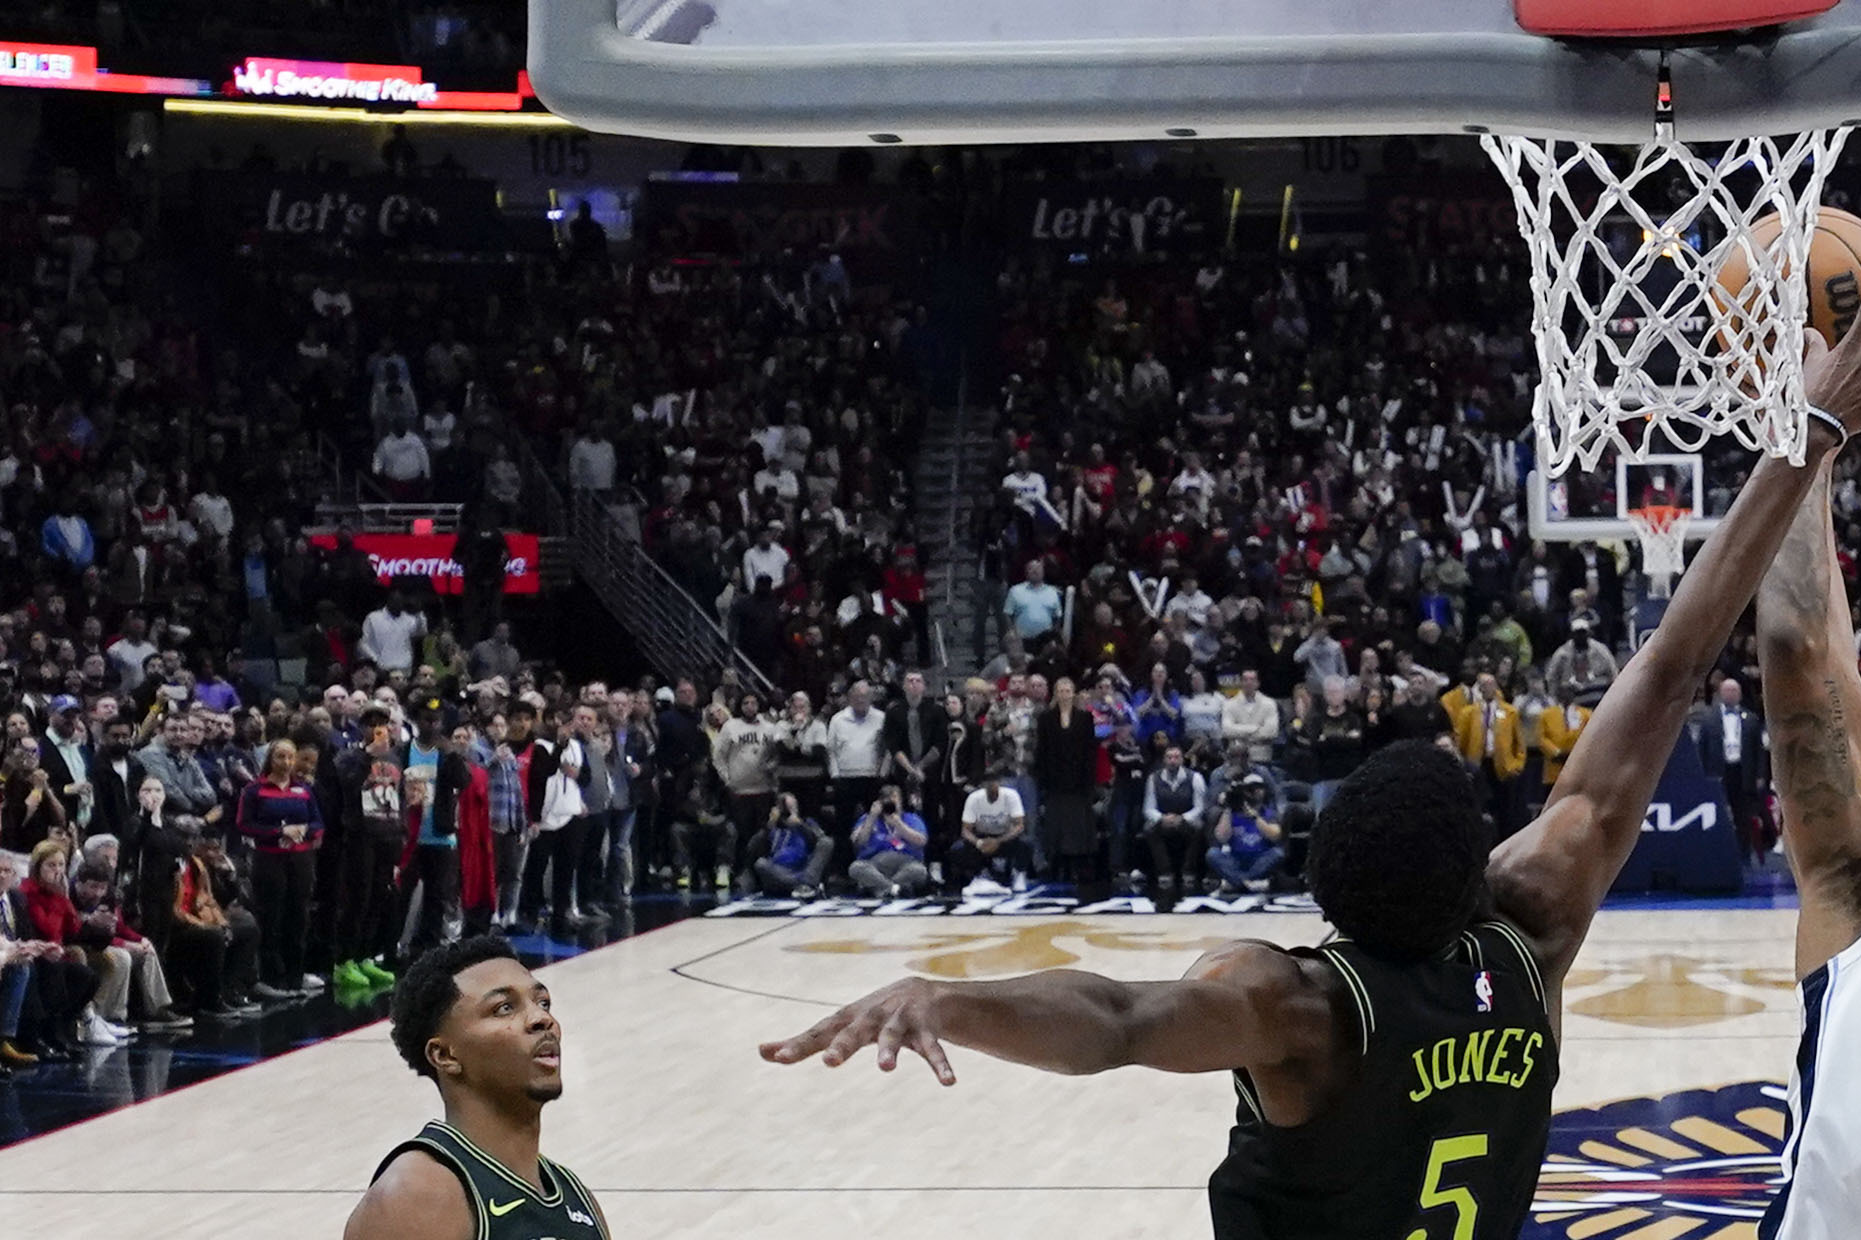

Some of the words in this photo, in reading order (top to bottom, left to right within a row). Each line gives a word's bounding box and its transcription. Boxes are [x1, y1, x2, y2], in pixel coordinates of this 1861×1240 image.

[530, 133, 591, 178] 105
[266, 188, 366, 234] Let's
[1409, 1027, 1544, 1102] JONES
